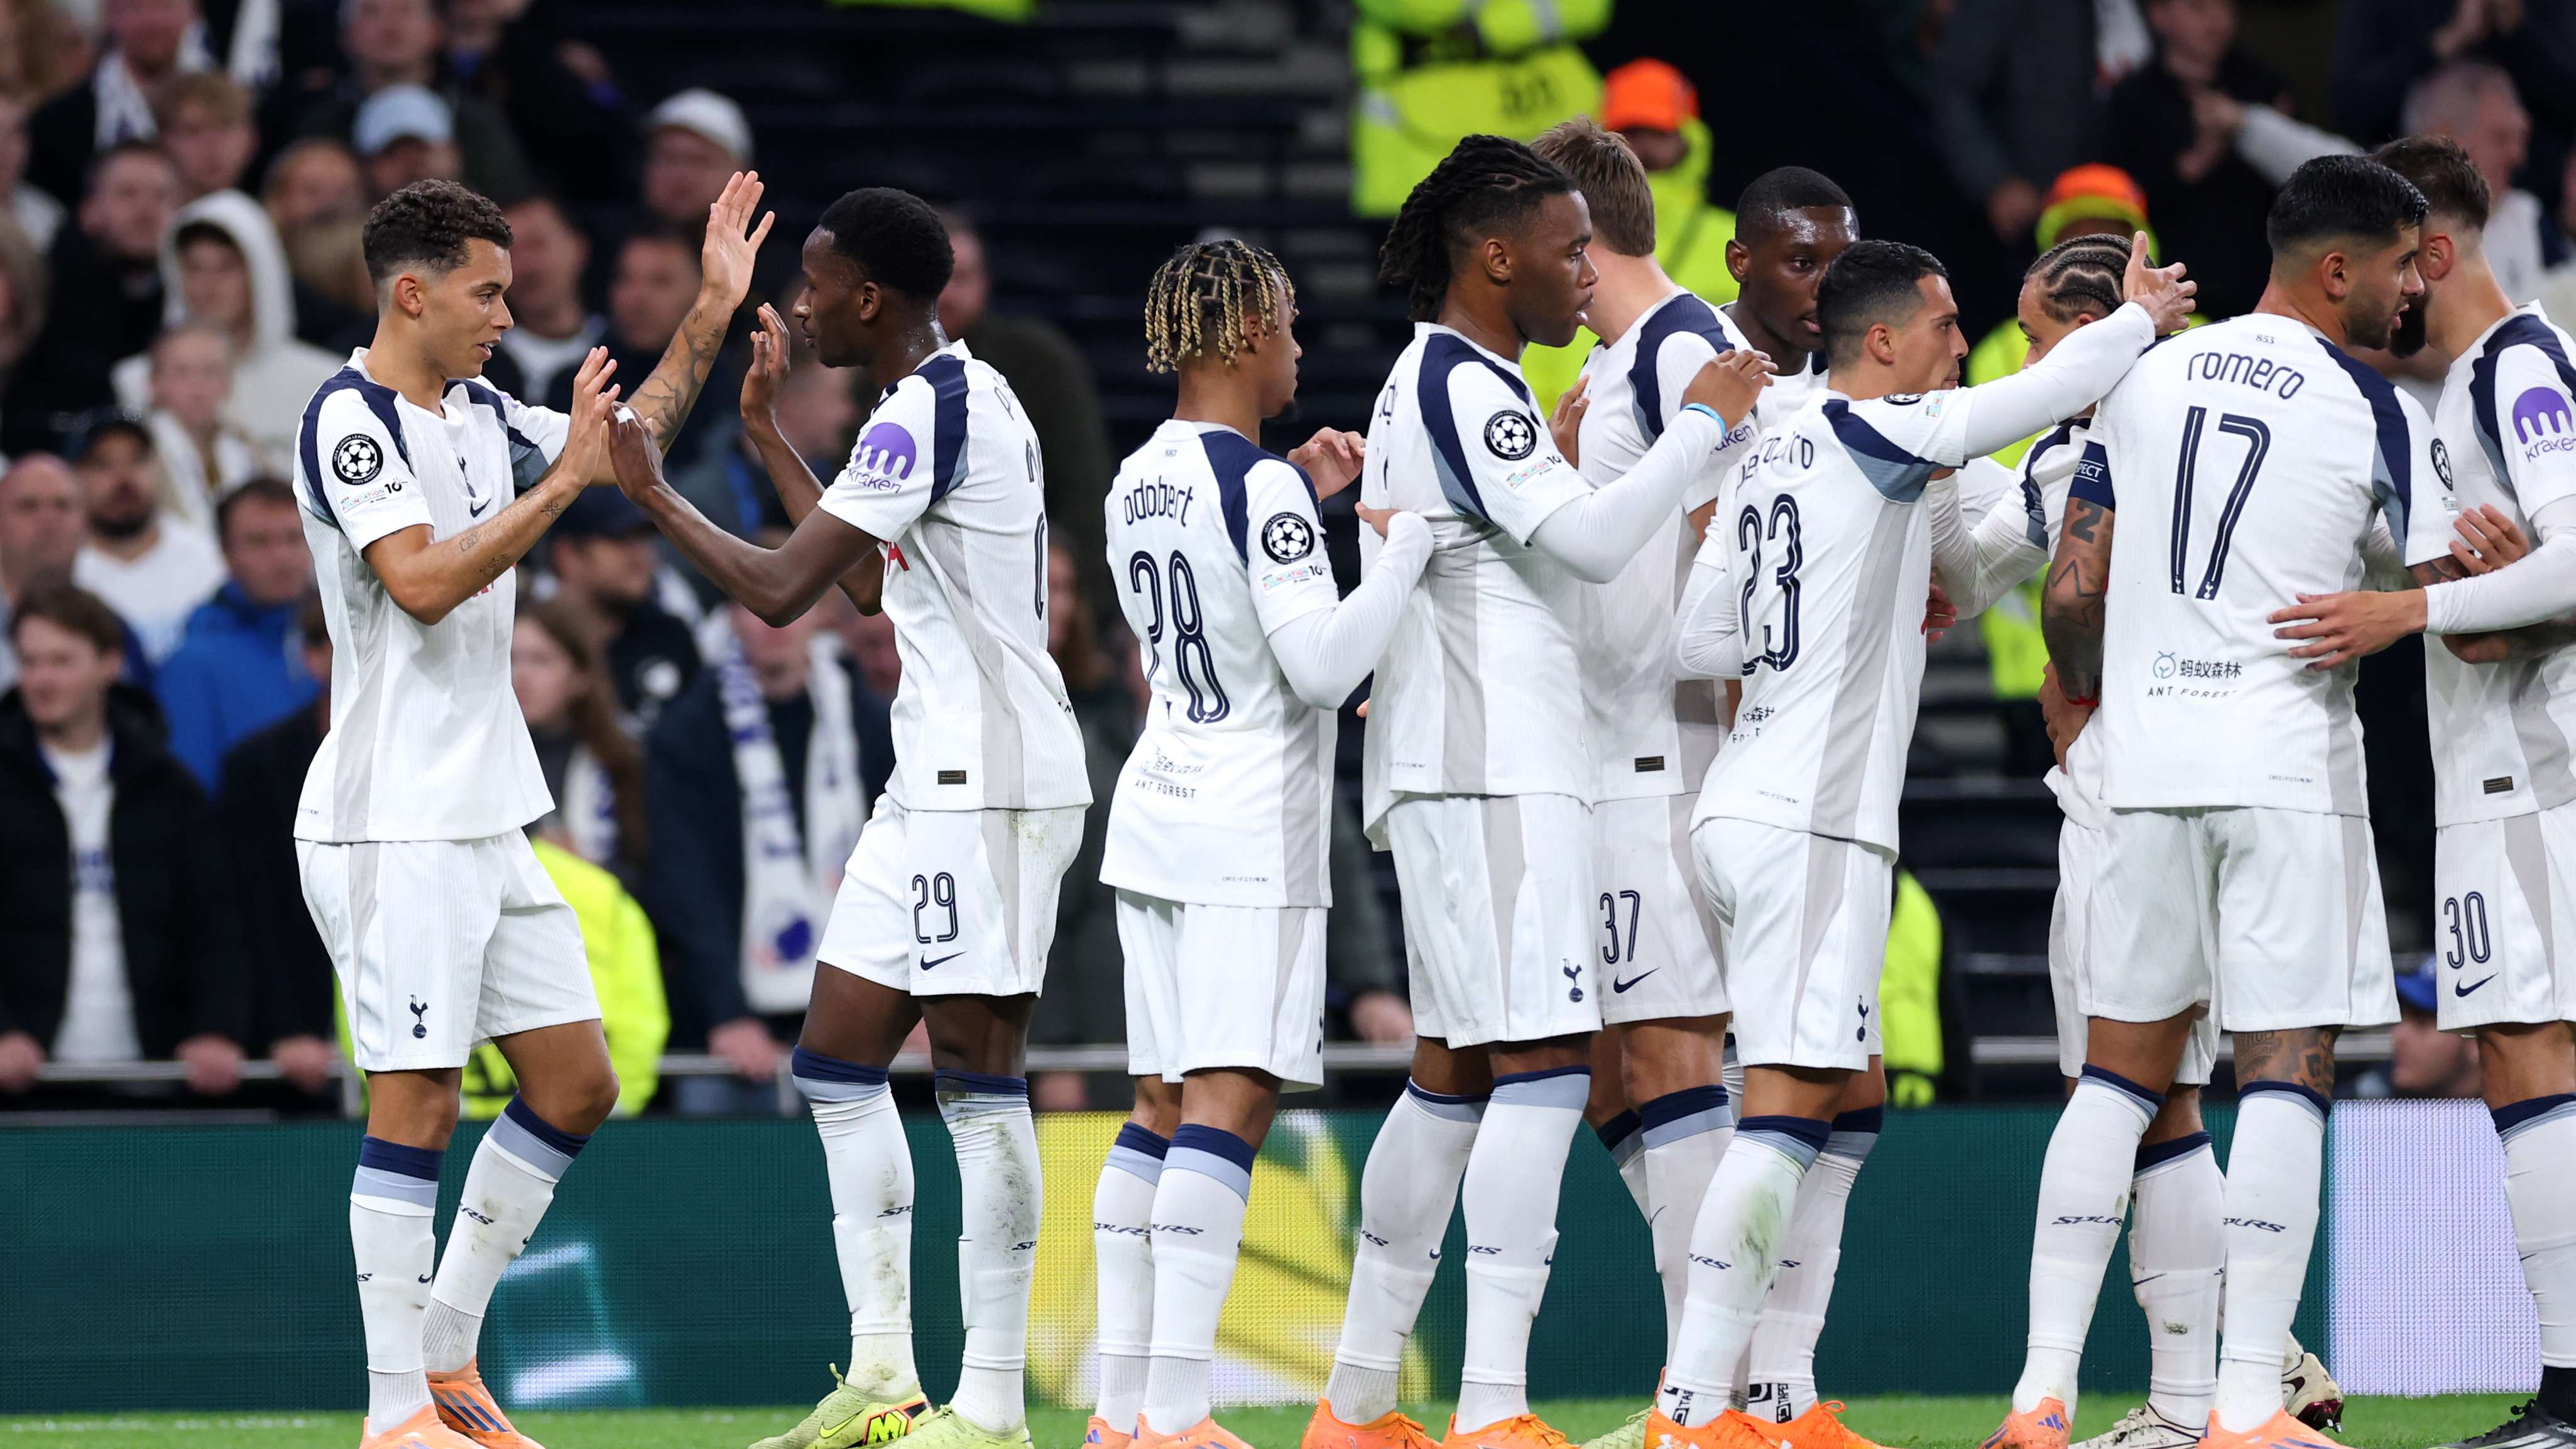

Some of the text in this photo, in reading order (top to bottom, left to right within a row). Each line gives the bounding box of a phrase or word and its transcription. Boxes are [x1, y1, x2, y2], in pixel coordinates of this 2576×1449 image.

[2256, 334, 2275, 344] 853
[2187, 352, 2305, 400] romero
[847, 468, 902, 494] kraken
[2076, 462, 2103, 478] PECT
[1124, 475, 1193, 527] odobert
[2171, 405, 2271, 600] 17
[1738, 493, 1803, 676] 23
[1130, 550, 1230, 724] 28
[2148, 686, 2237, 698] ANT FORES
[2180, 659, 2242, 679] 蚂蚁森林
[1157, 783, 1196, 799] FOREST
[912, 872, 959, 944] 29
[1600, 890, 1640, 965] 37
[2444, 891, 2491, 970] 30
